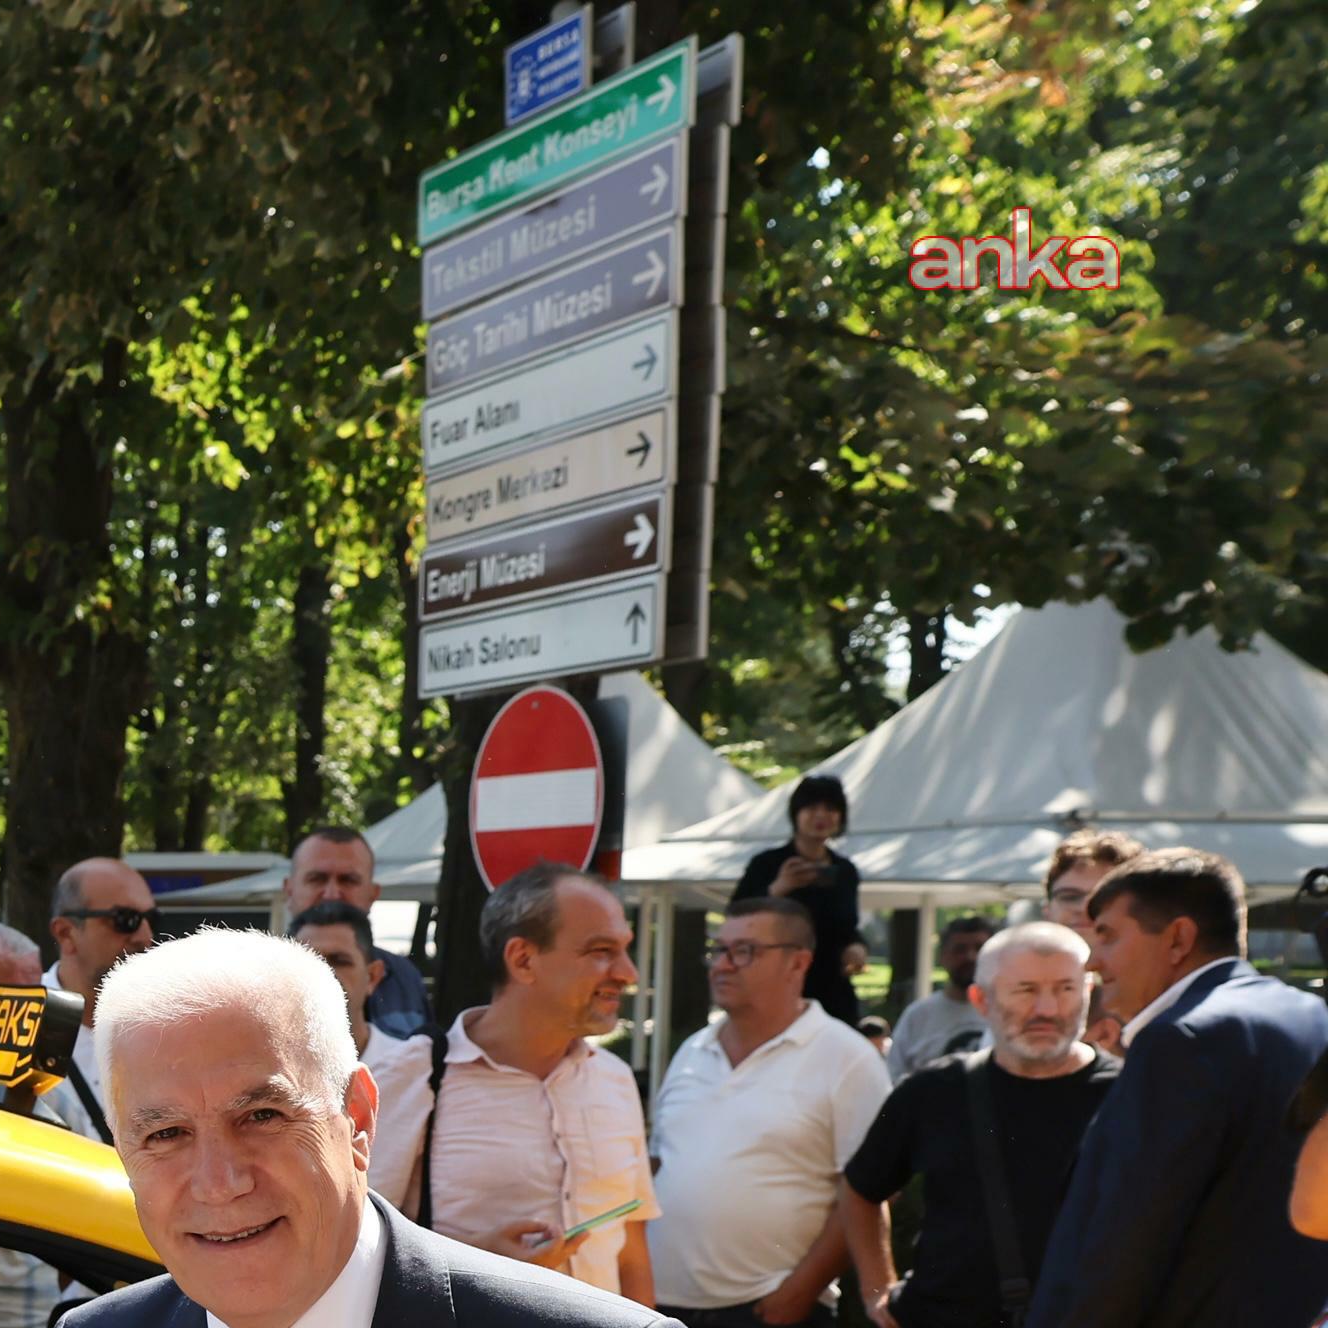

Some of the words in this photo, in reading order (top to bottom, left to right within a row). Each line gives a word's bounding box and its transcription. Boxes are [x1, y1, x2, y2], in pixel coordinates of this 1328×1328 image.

[427, 176, 484, 221] Bursa
[489, 143, 539, 192] Kent
[544, 93, 638, 165] Konseyi
[432, 237, 504, 295] Tekstil
[510, 194, 596, 263] Müzesi
[433, 334, 469, 374] Göç
[473, 305, 528, 358] Tarihi
[532, 271, 612, 336] Müzesi
[431, 417, 469, 448] Fuar
[474, 400, 520, 435] Alanı
[432, 488, 492, 523] Kongre
[497, 456, 569, 504] Merkezi
[427, 560, 477, 602] Enerji
[481, 542, 546, 590] Müzesi
[427, 641, 475, 673] Nikah
[479, 633, 541, 665] Salonu
